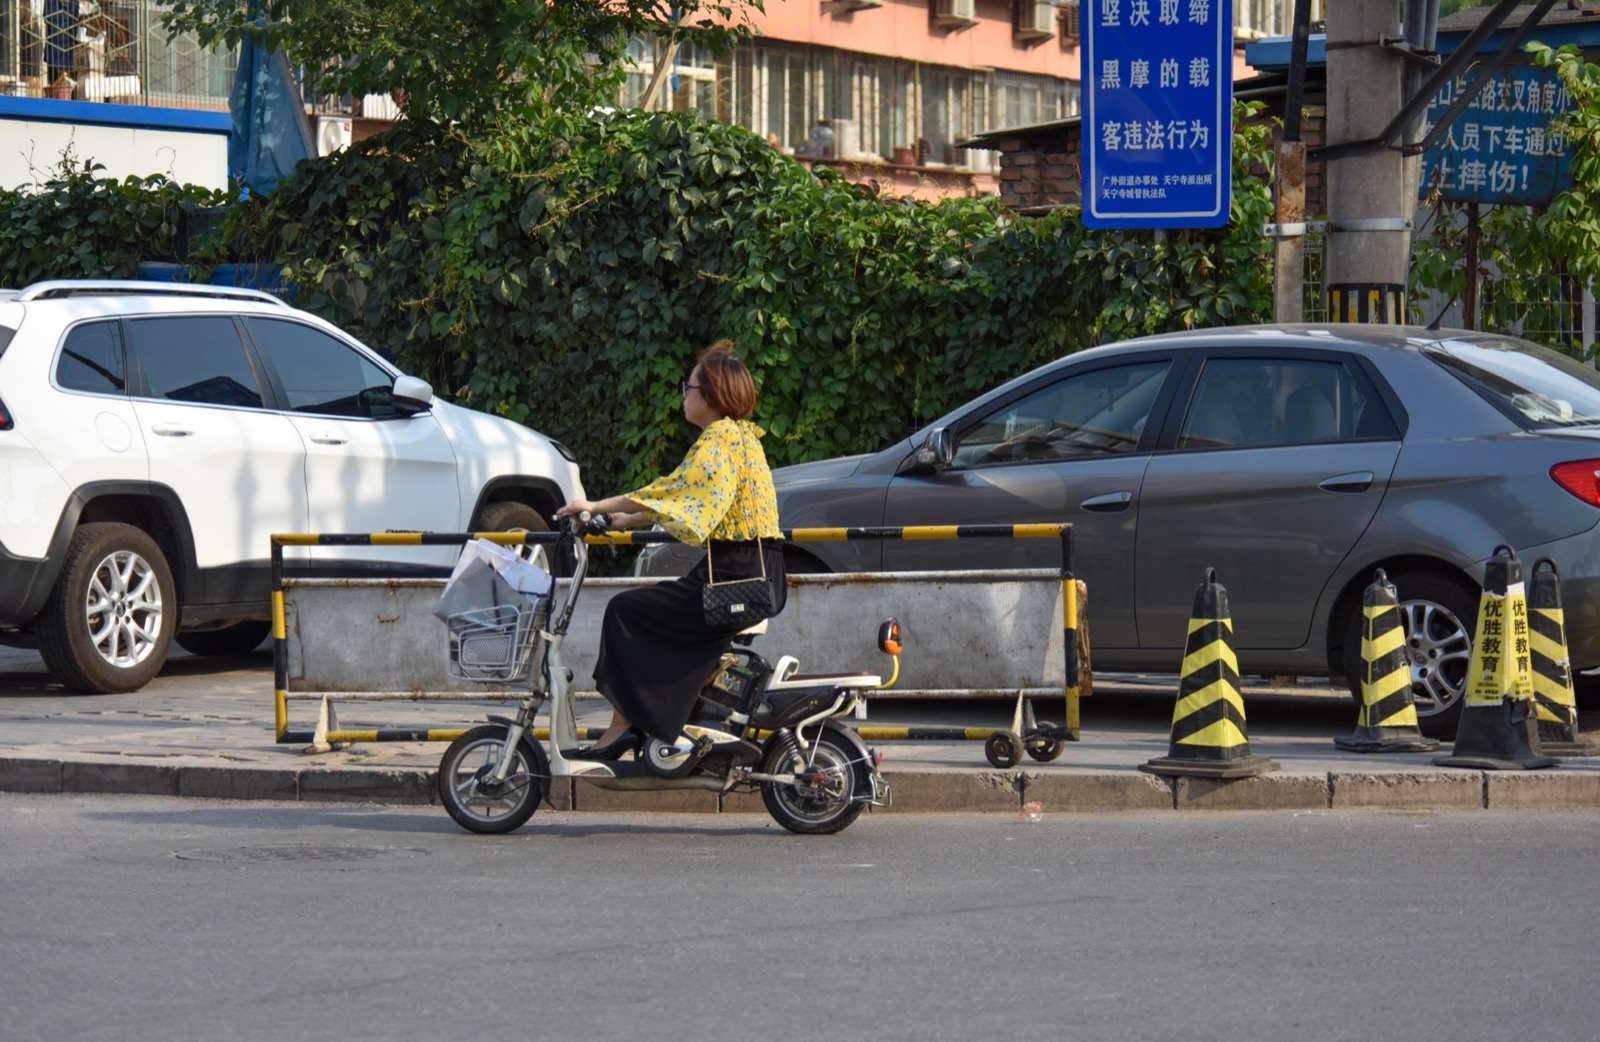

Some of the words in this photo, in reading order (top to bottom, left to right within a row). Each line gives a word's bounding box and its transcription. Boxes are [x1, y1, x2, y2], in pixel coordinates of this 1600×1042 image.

[1101, 0, 1210, 27] 坚决取缔
[1101, 57, 1210, 89] 黑摩的载
[1102, 119, 1209, 151] 客违法行为
[1426, 121, 1567, 158] 人员下车通过
[1102, 175, 1159, 186] 广外街道办事处
[1163, 174, 1213, 185] 天宁寺派出所
[1102, 188, 1167, 199] 天宁寺城管执法队
[1481, 600, 1503, 673] 优胜教育
[1512, 599, 1529, 673] 优胜教育
